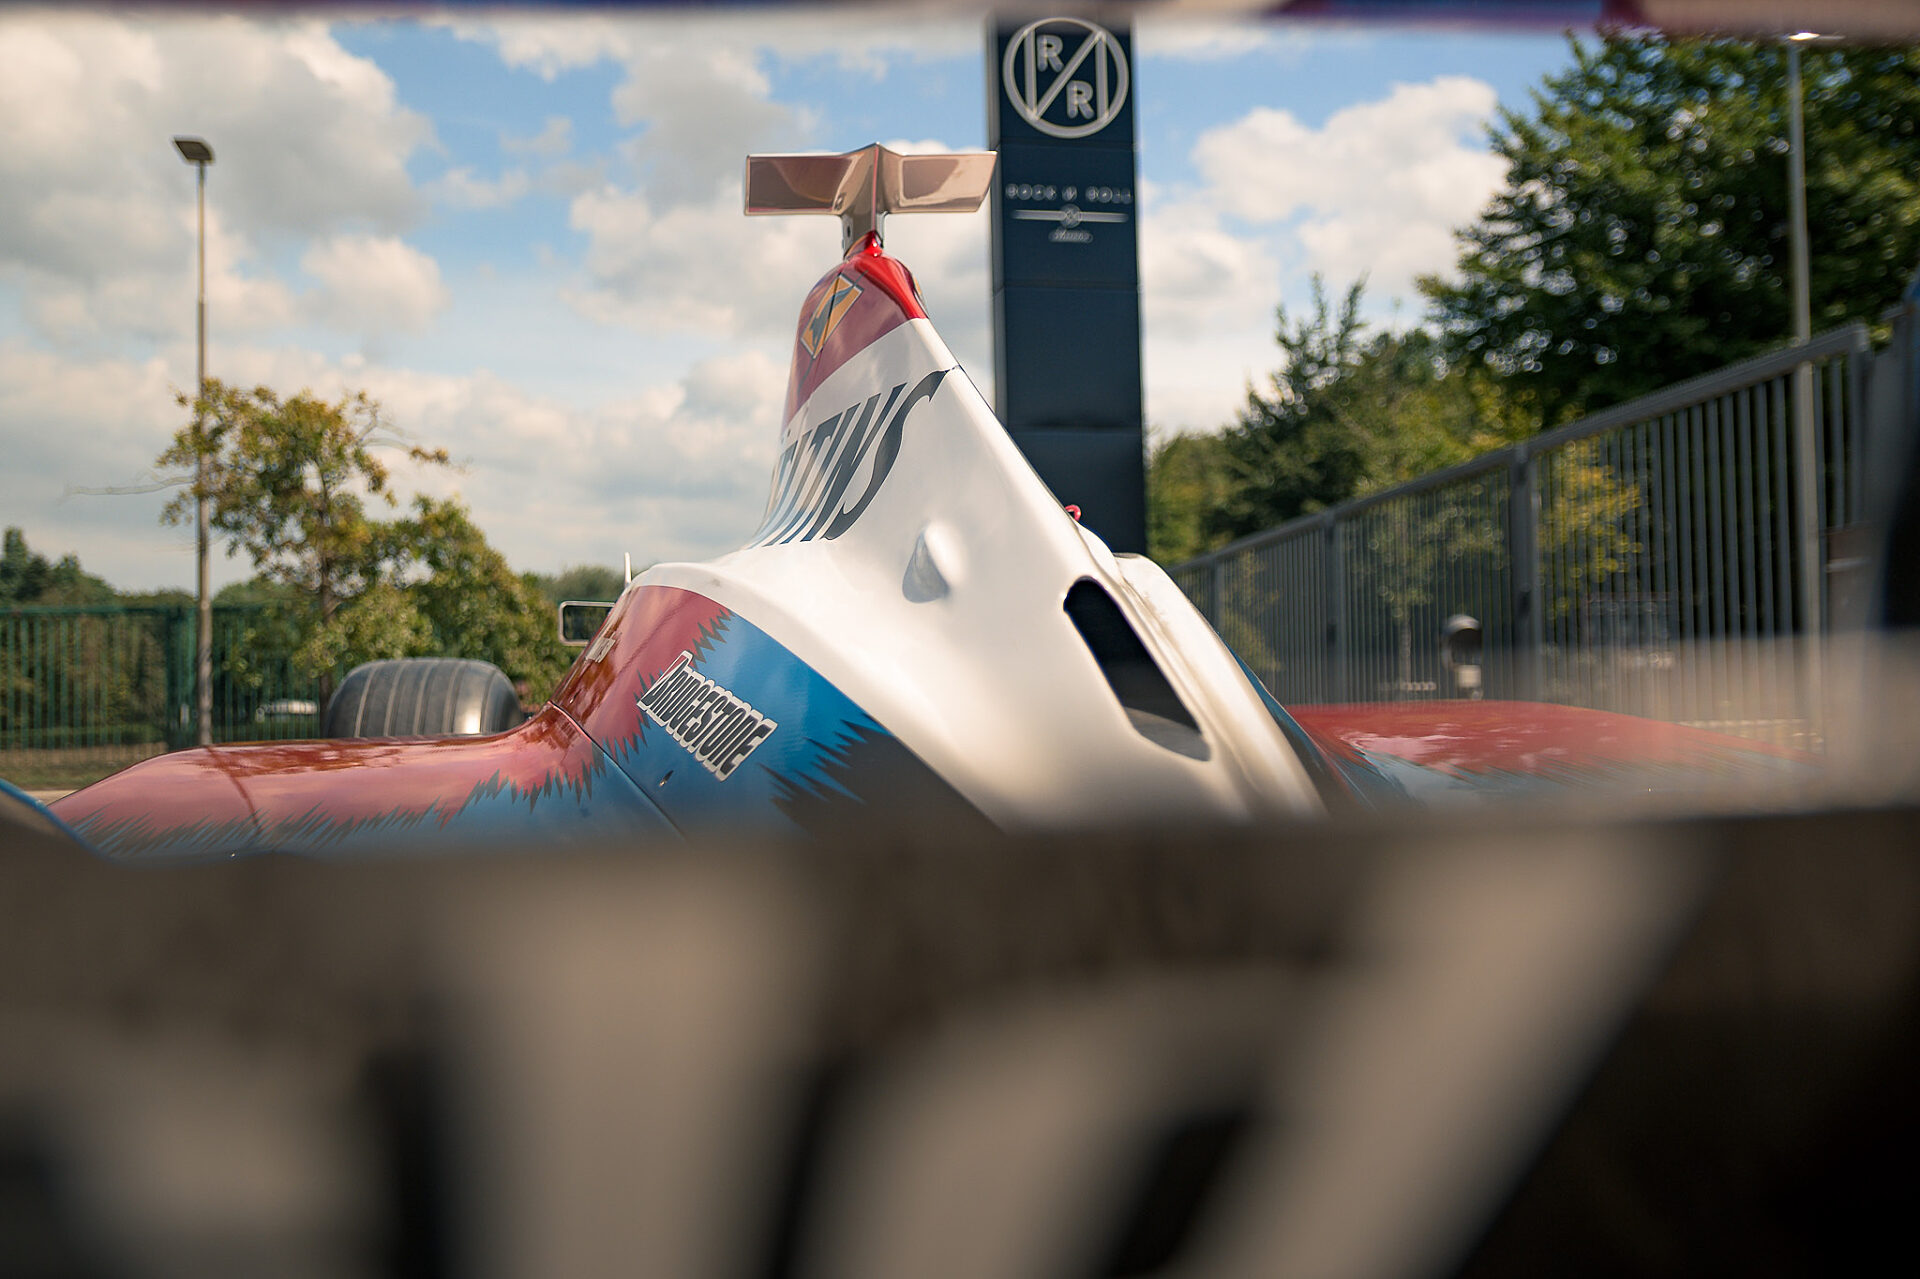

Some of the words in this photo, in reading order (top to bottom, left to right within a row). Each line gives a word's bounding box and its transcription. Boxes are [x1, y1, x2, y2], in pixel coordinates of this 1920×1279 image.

[1036, 35, 1063, 72] R
[1066, 80, 1094, 119] R
[638, 652, 776, 780] BRIDGESTONE
